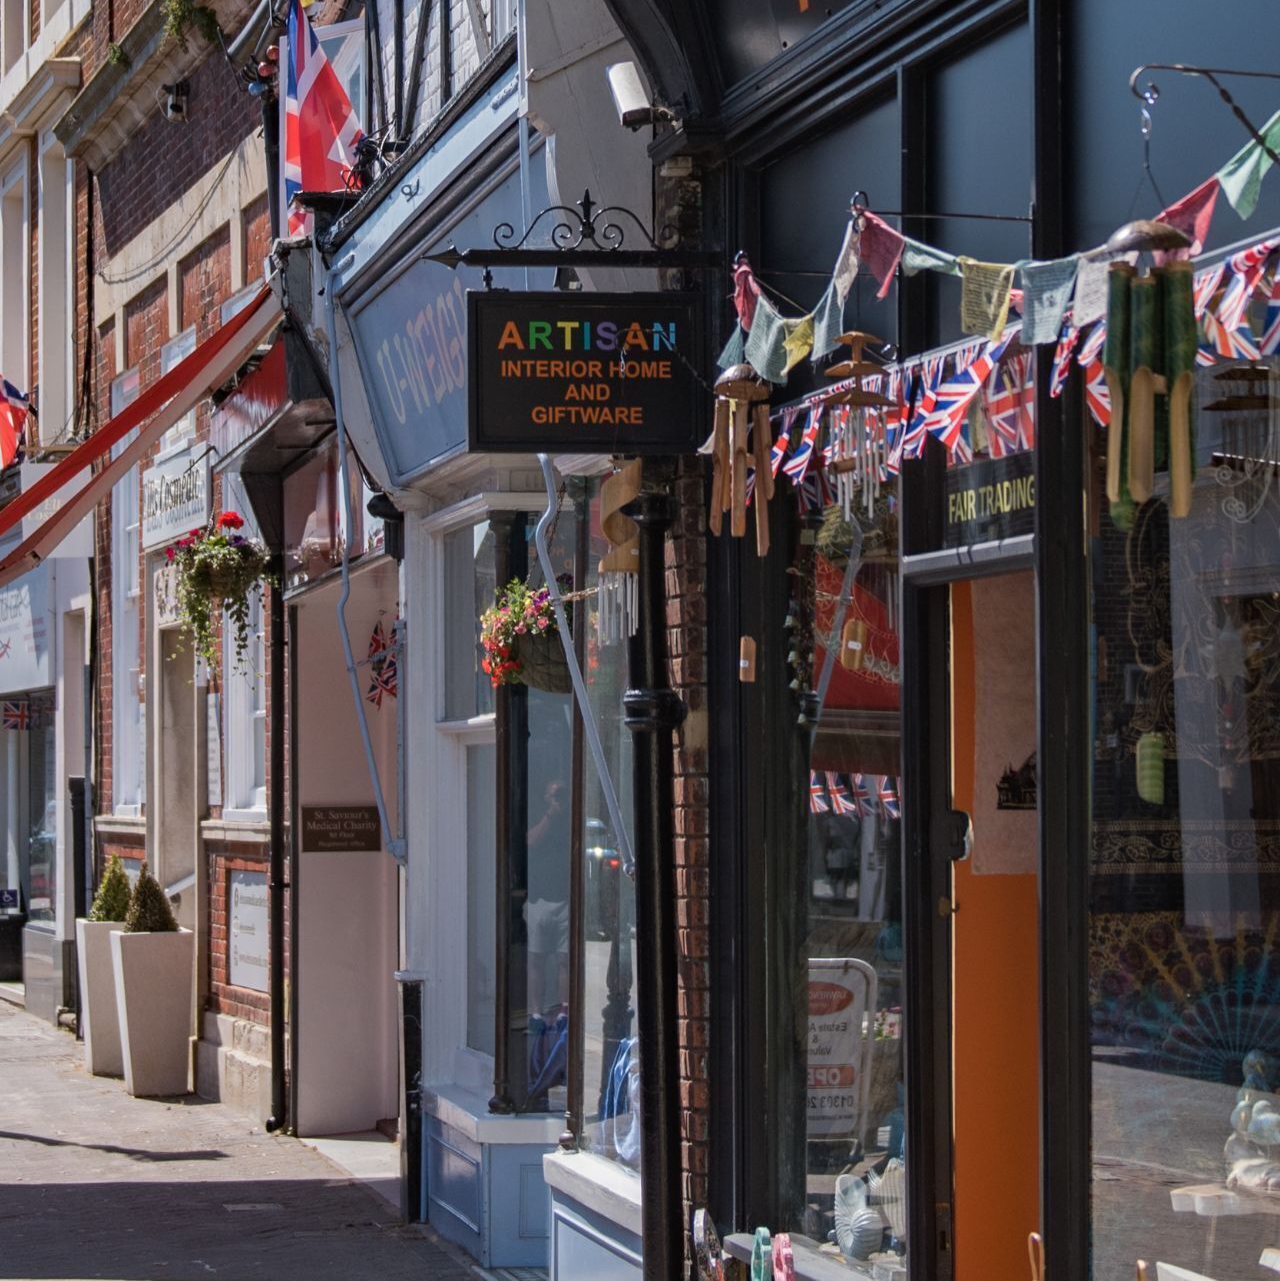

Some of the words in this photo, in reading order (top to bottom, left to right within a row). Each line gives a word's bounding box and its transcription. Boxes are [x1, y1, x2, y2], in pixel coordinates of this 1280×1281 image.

[498, 320, 676, 351] ARTISAN
[501, 360, 602, 378] INTERIOR
[609, 360, 672, 378] HOME
[565, 383, 610, 401] AND
[531, 406, 643, 424] GIFTWARE
[948, 489, 976, 524] FAIR
[979, 475, 1035, 517] TRADING
[328, 810, 369, 820] Saviour's
[306, 821, 341, 830] Medical
[343, 821, 377, 831] Charity
